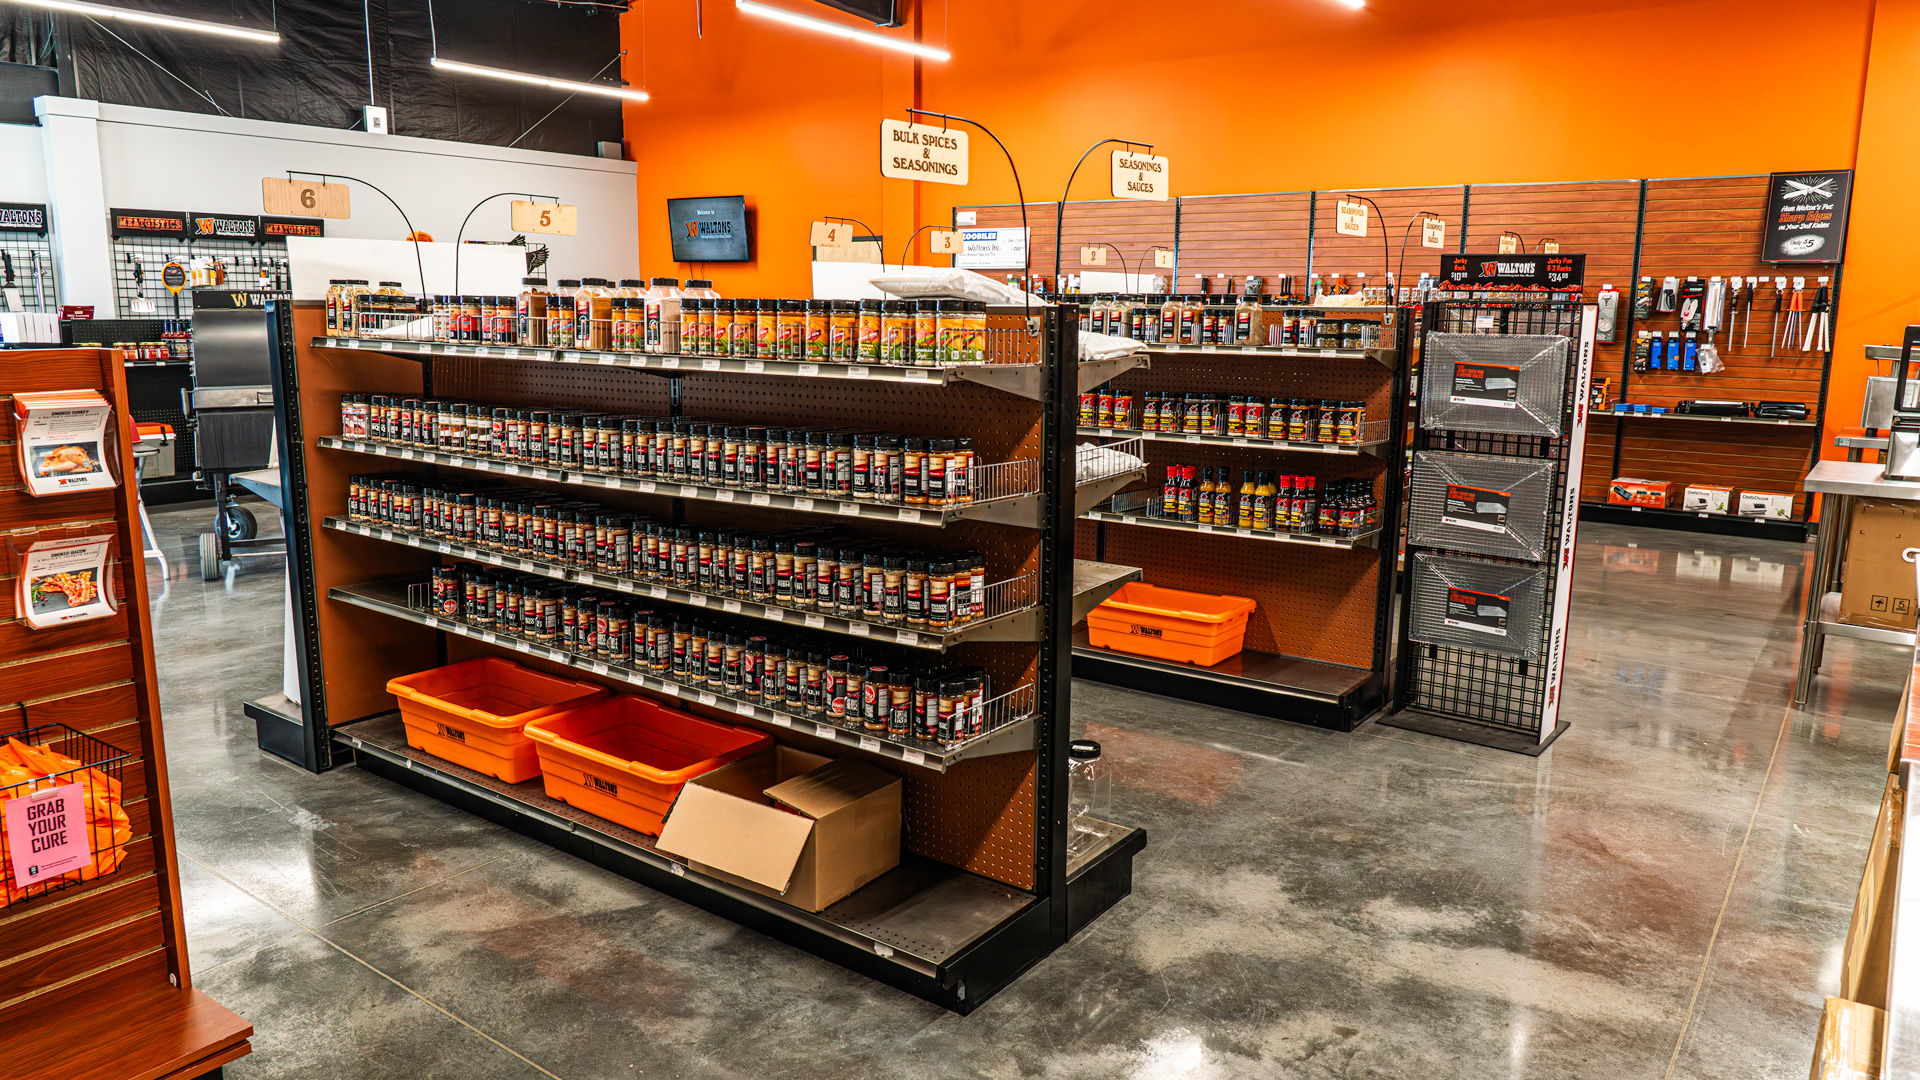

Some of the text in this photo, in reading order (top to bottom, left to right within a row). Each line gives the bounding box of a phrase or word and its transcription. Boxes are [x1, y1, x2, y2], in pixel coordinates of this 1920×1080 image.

[893, 130, 958, 150] BULK SPICES
[922, 148, 930, 159] &
[892, 157, 958, 176] SEASONINGS
[1119, 158, 1162, 172] SEASONINGS
[1138, 172, 1143, 181] &
[1128, 181, 1154, 192] SAUCES
[300, 188, 316, 208] 6
[539, 210, 552, 227] 5
[1806, 211, 1832, 222] Edges
[118, 218, 181, 230] MEATGISTICS
[266, 224, 320, 236] MEATGISTICS
[828, 228, 835, 242] 4
[944, 237, 950, 248] 3
[1091, 251, 1096, 261] 2
[1162, 255, 1166, 264] 1
[1498, 262, 1536, 274] WALTON'S
[27, 798, 65, 820] GRAB
[28, 814, 66, 836] YOUR
[31, 830, 68, 853] CURE
